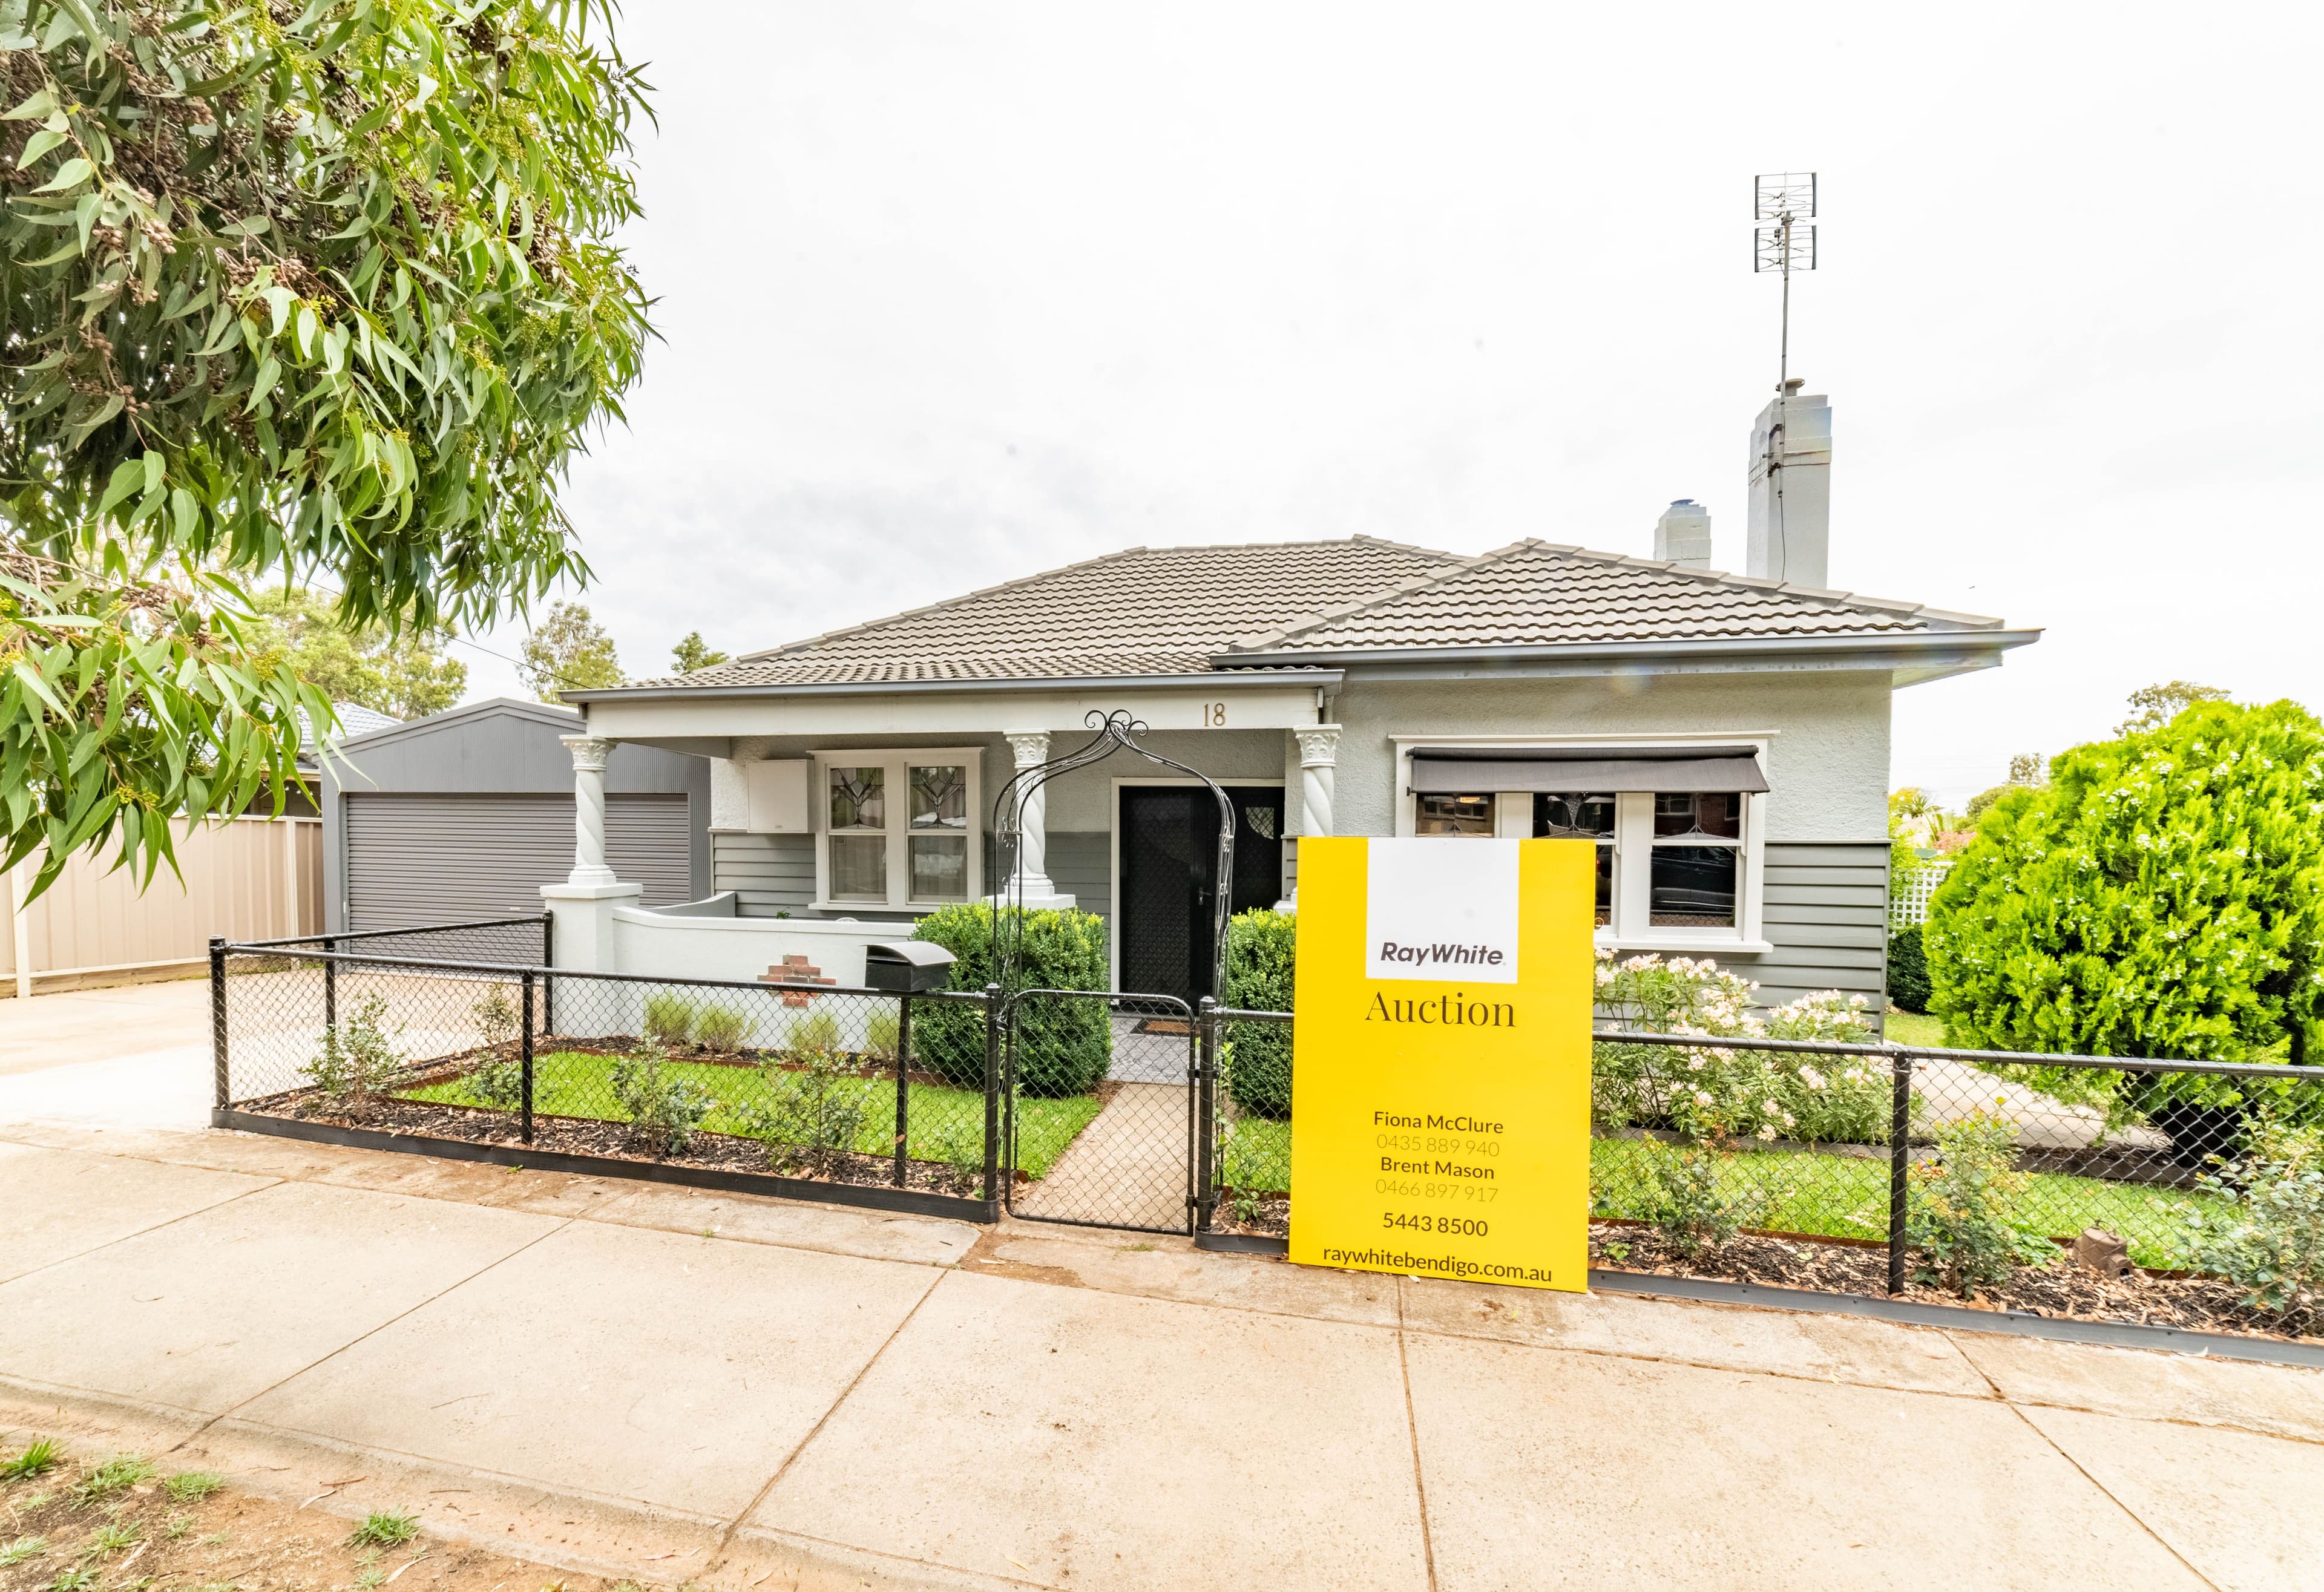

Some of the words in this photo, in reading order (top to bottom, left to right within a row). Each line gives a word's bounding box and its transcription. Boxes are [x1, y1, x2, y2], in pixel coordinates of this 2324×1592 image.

[1204, 703, 1226, 727] 18
[1380, 942, 1503, 967] RayWhite
[1365, 991, 1517, 1027] Auction
[1374, 1111, 1422, 1128] Fiona
[1427, 1115, 1504, 1134] McClure
[1376, 1134, 1421, 1150] 0435
[1426, 1138, 1460, 1153] 889
[1465, 1141, 1500, 1157] 940
[1380, 1156, 1430, 1174] Brent
[1434, 1161, 1495, 1180] Mason
[1375, 1179, 1420, 1196] 0466
[1426, 1183, 1459, 1199] 897
[1464, 1186, 1498, 1202] 917
[1383, 1213, 1432, 1232] 5443
[1437, 1217, 1488, 1237] 8500
[1324, 1248, 1552, 1282] raywhitebendigo.com.au
